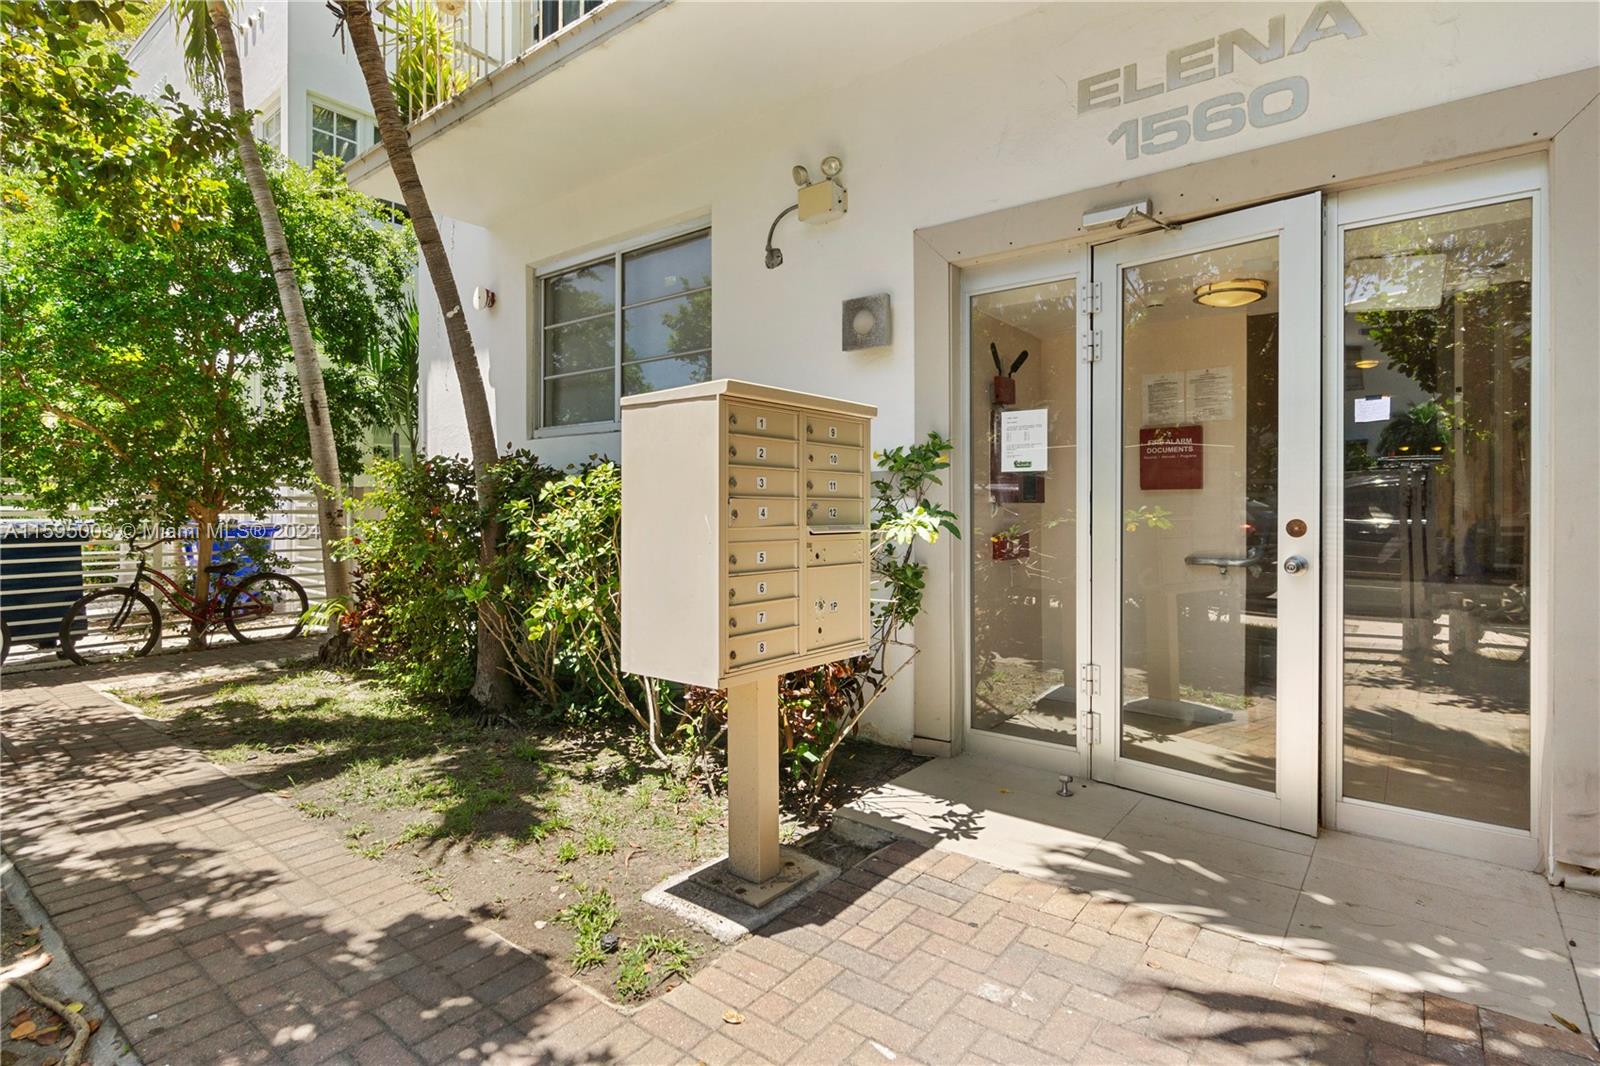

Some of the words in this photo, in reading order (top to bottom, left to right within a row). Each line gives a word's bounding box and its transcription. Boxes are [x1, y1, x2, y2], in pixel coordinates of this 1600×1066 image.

[1077, 0, 1367, 114] ELENA
[1107, 75, 1310, 160] 1560
[1146, 445, 1194, 454] DOCUMENTS
